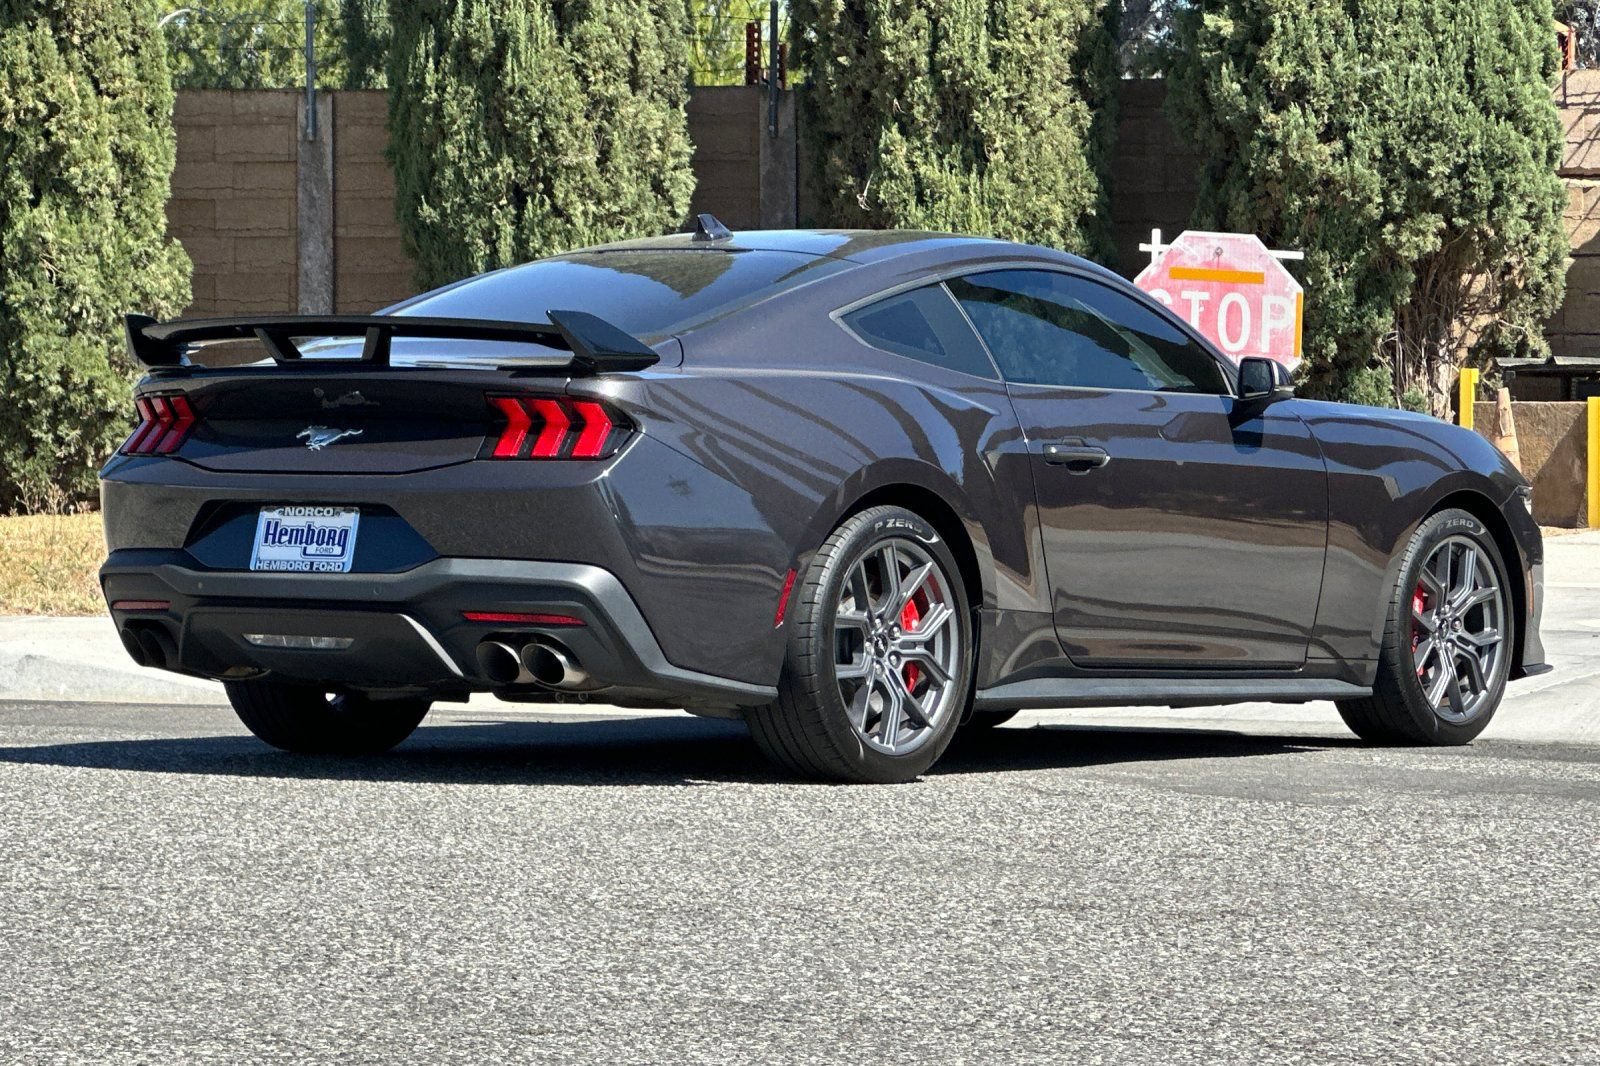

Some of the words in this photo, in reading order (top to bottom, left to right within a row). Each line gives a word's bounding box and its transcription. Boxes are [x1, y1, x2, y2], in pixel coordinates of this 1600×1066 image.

[1149, 287, 1292, 354] TOP
[284, 507, 334, 517] NORCO
[255, 560, 310, 571] HEMBORG
[312, 562, 344, 572] FORD
